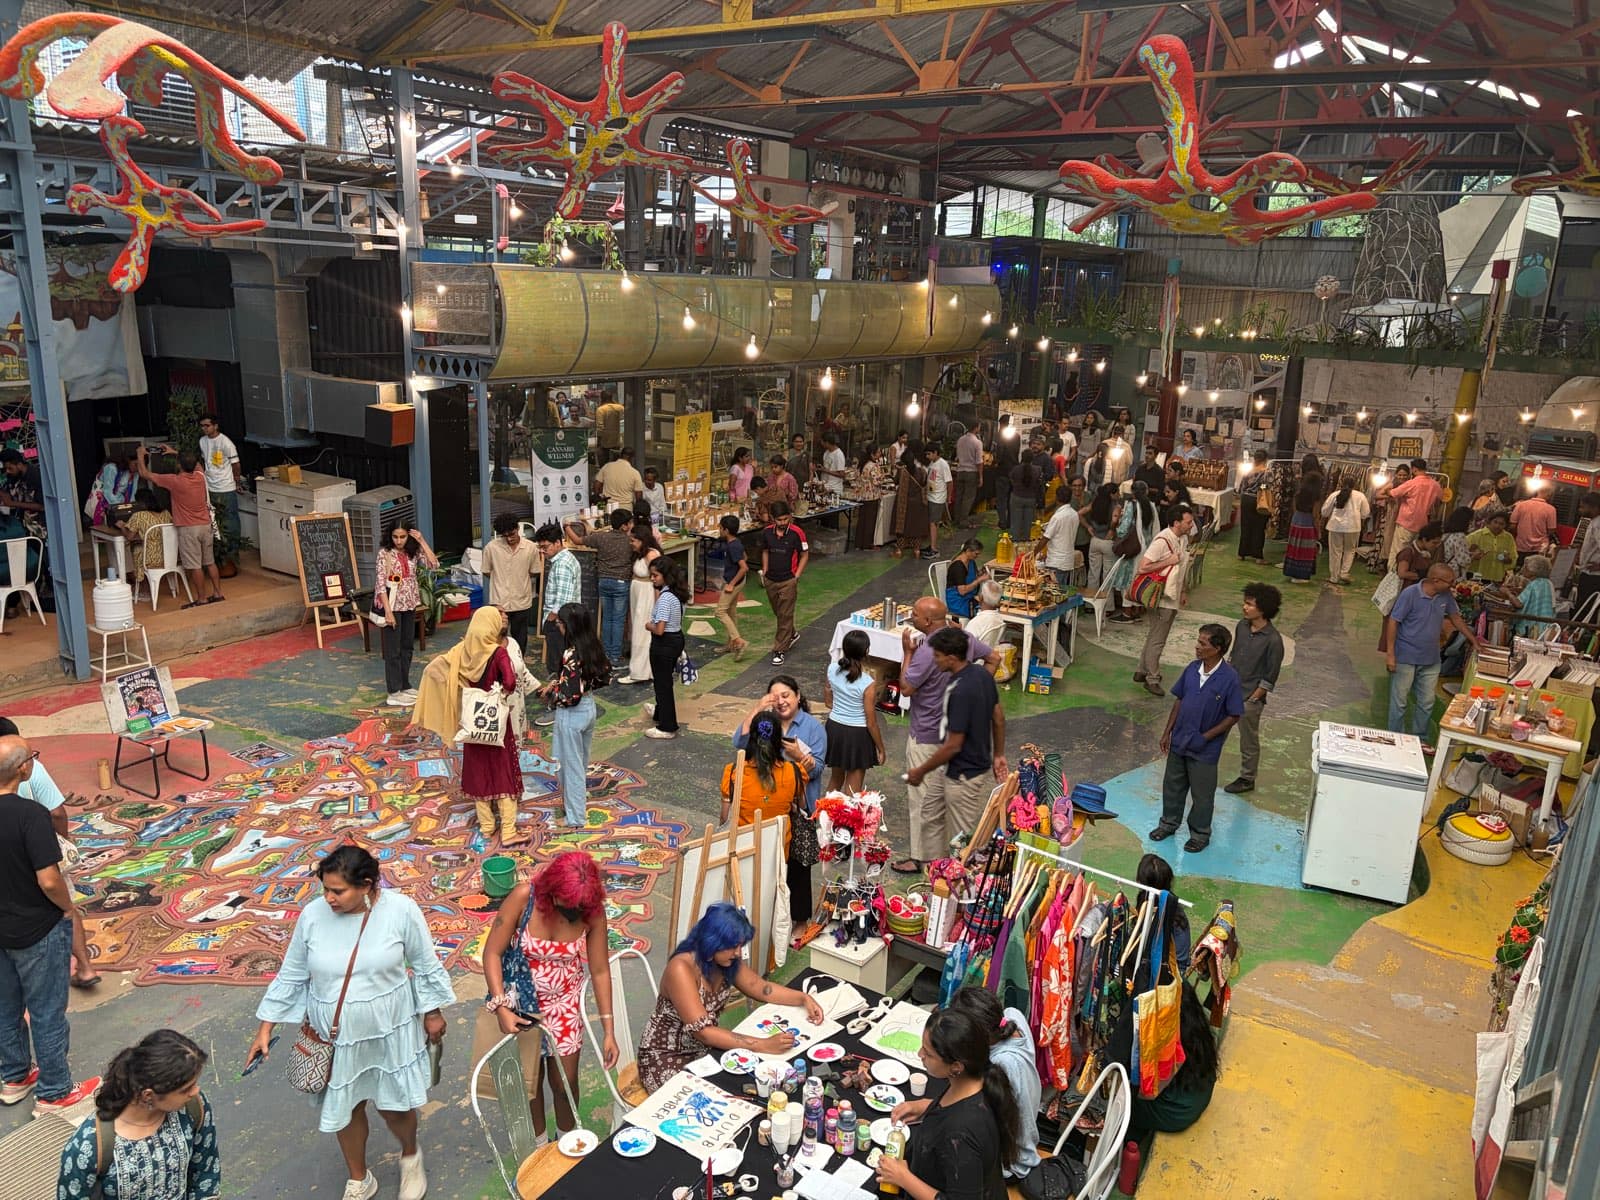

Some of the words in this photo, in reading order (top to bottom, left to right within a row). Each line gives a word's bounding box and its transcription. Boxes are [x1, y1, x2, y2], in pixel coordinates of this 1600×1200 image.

[471, 731, 499, 742] VITM
[651, 1085, 693, 1120] DUMBER
[702, 1113, 741, 1148] DUMB
